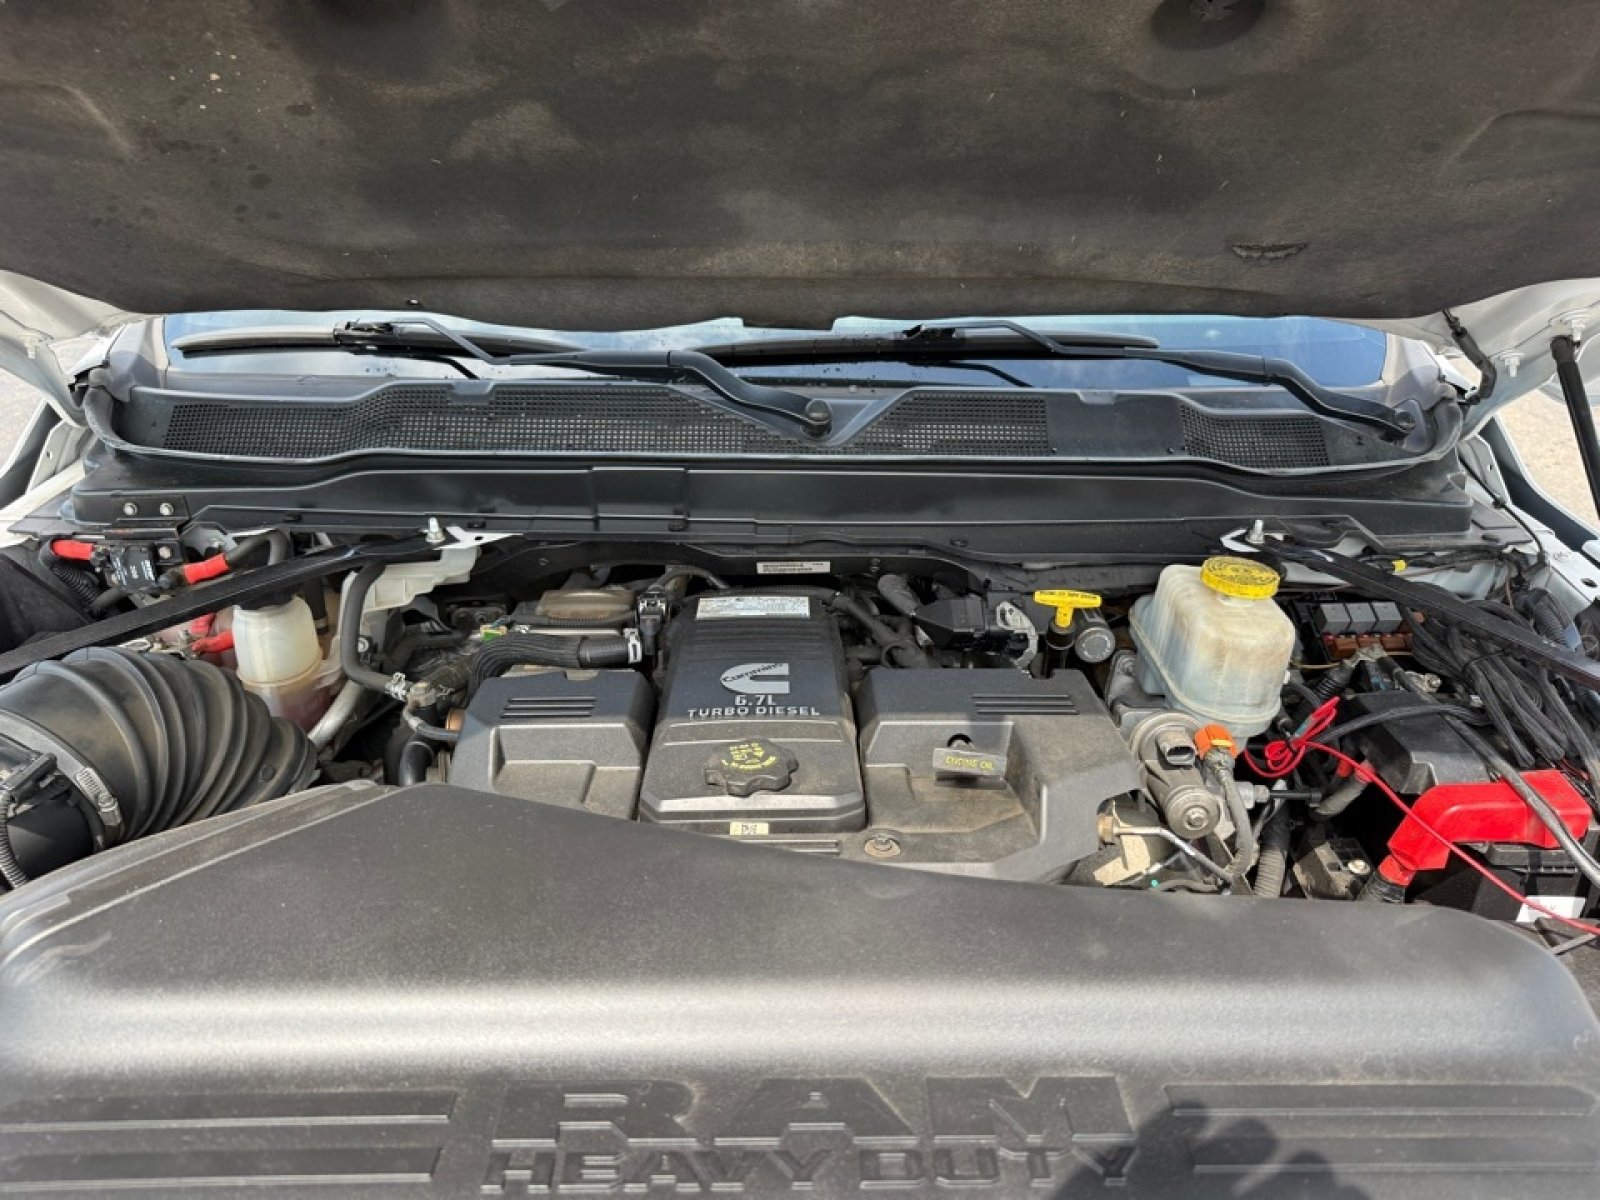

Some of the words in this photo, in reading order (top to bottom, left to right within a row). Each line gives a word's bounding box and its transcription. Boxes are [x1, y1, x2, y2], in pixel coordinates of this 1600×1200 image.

[735, 695, 777, 706] 6.7L
[688, 706, 749, 718] TURBO
[756, 706, 821, 717] DIESEL
[946, 756, 976, 768] ENGINE
[979, 761, 993, 771] OIL
[491, 1075, 1136, 1147] RAM
[479, 1148, 835, 1195] HEAVY
[858, 1146, 1138, 1193] DUTY
